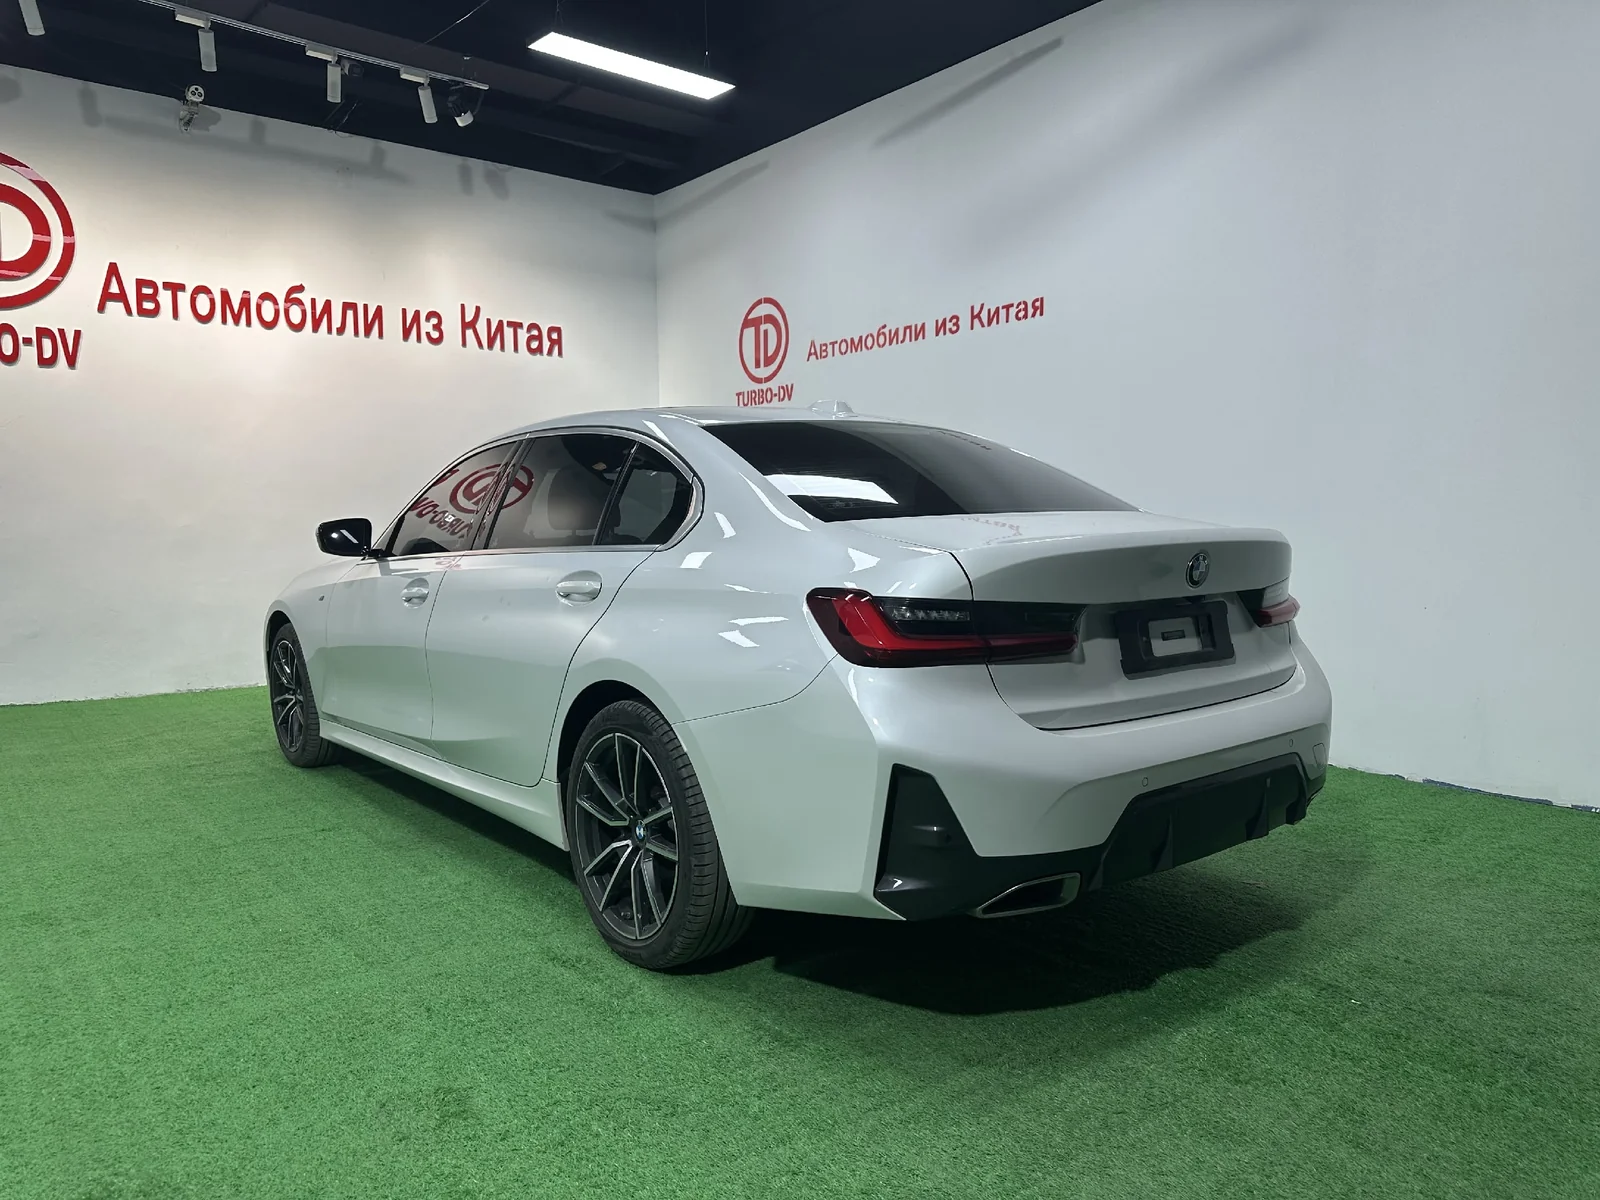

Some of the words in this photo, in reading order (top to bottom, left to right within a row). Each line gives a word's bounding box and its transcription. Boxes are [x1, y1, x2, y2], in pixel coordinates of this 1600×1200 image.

[97, 262, 385, 338] Автомобили
[402, 307, 445, 346] из
[459, 303, 564, 358] Китая
[806, 322, 926, 362] Автомобили
[935, 314, 961, 337] из
[969, 296, 1045, 331] Китая
[0, 322, 82, 369] O-DV
[735, 383, 794, 407] TURBO-DV
